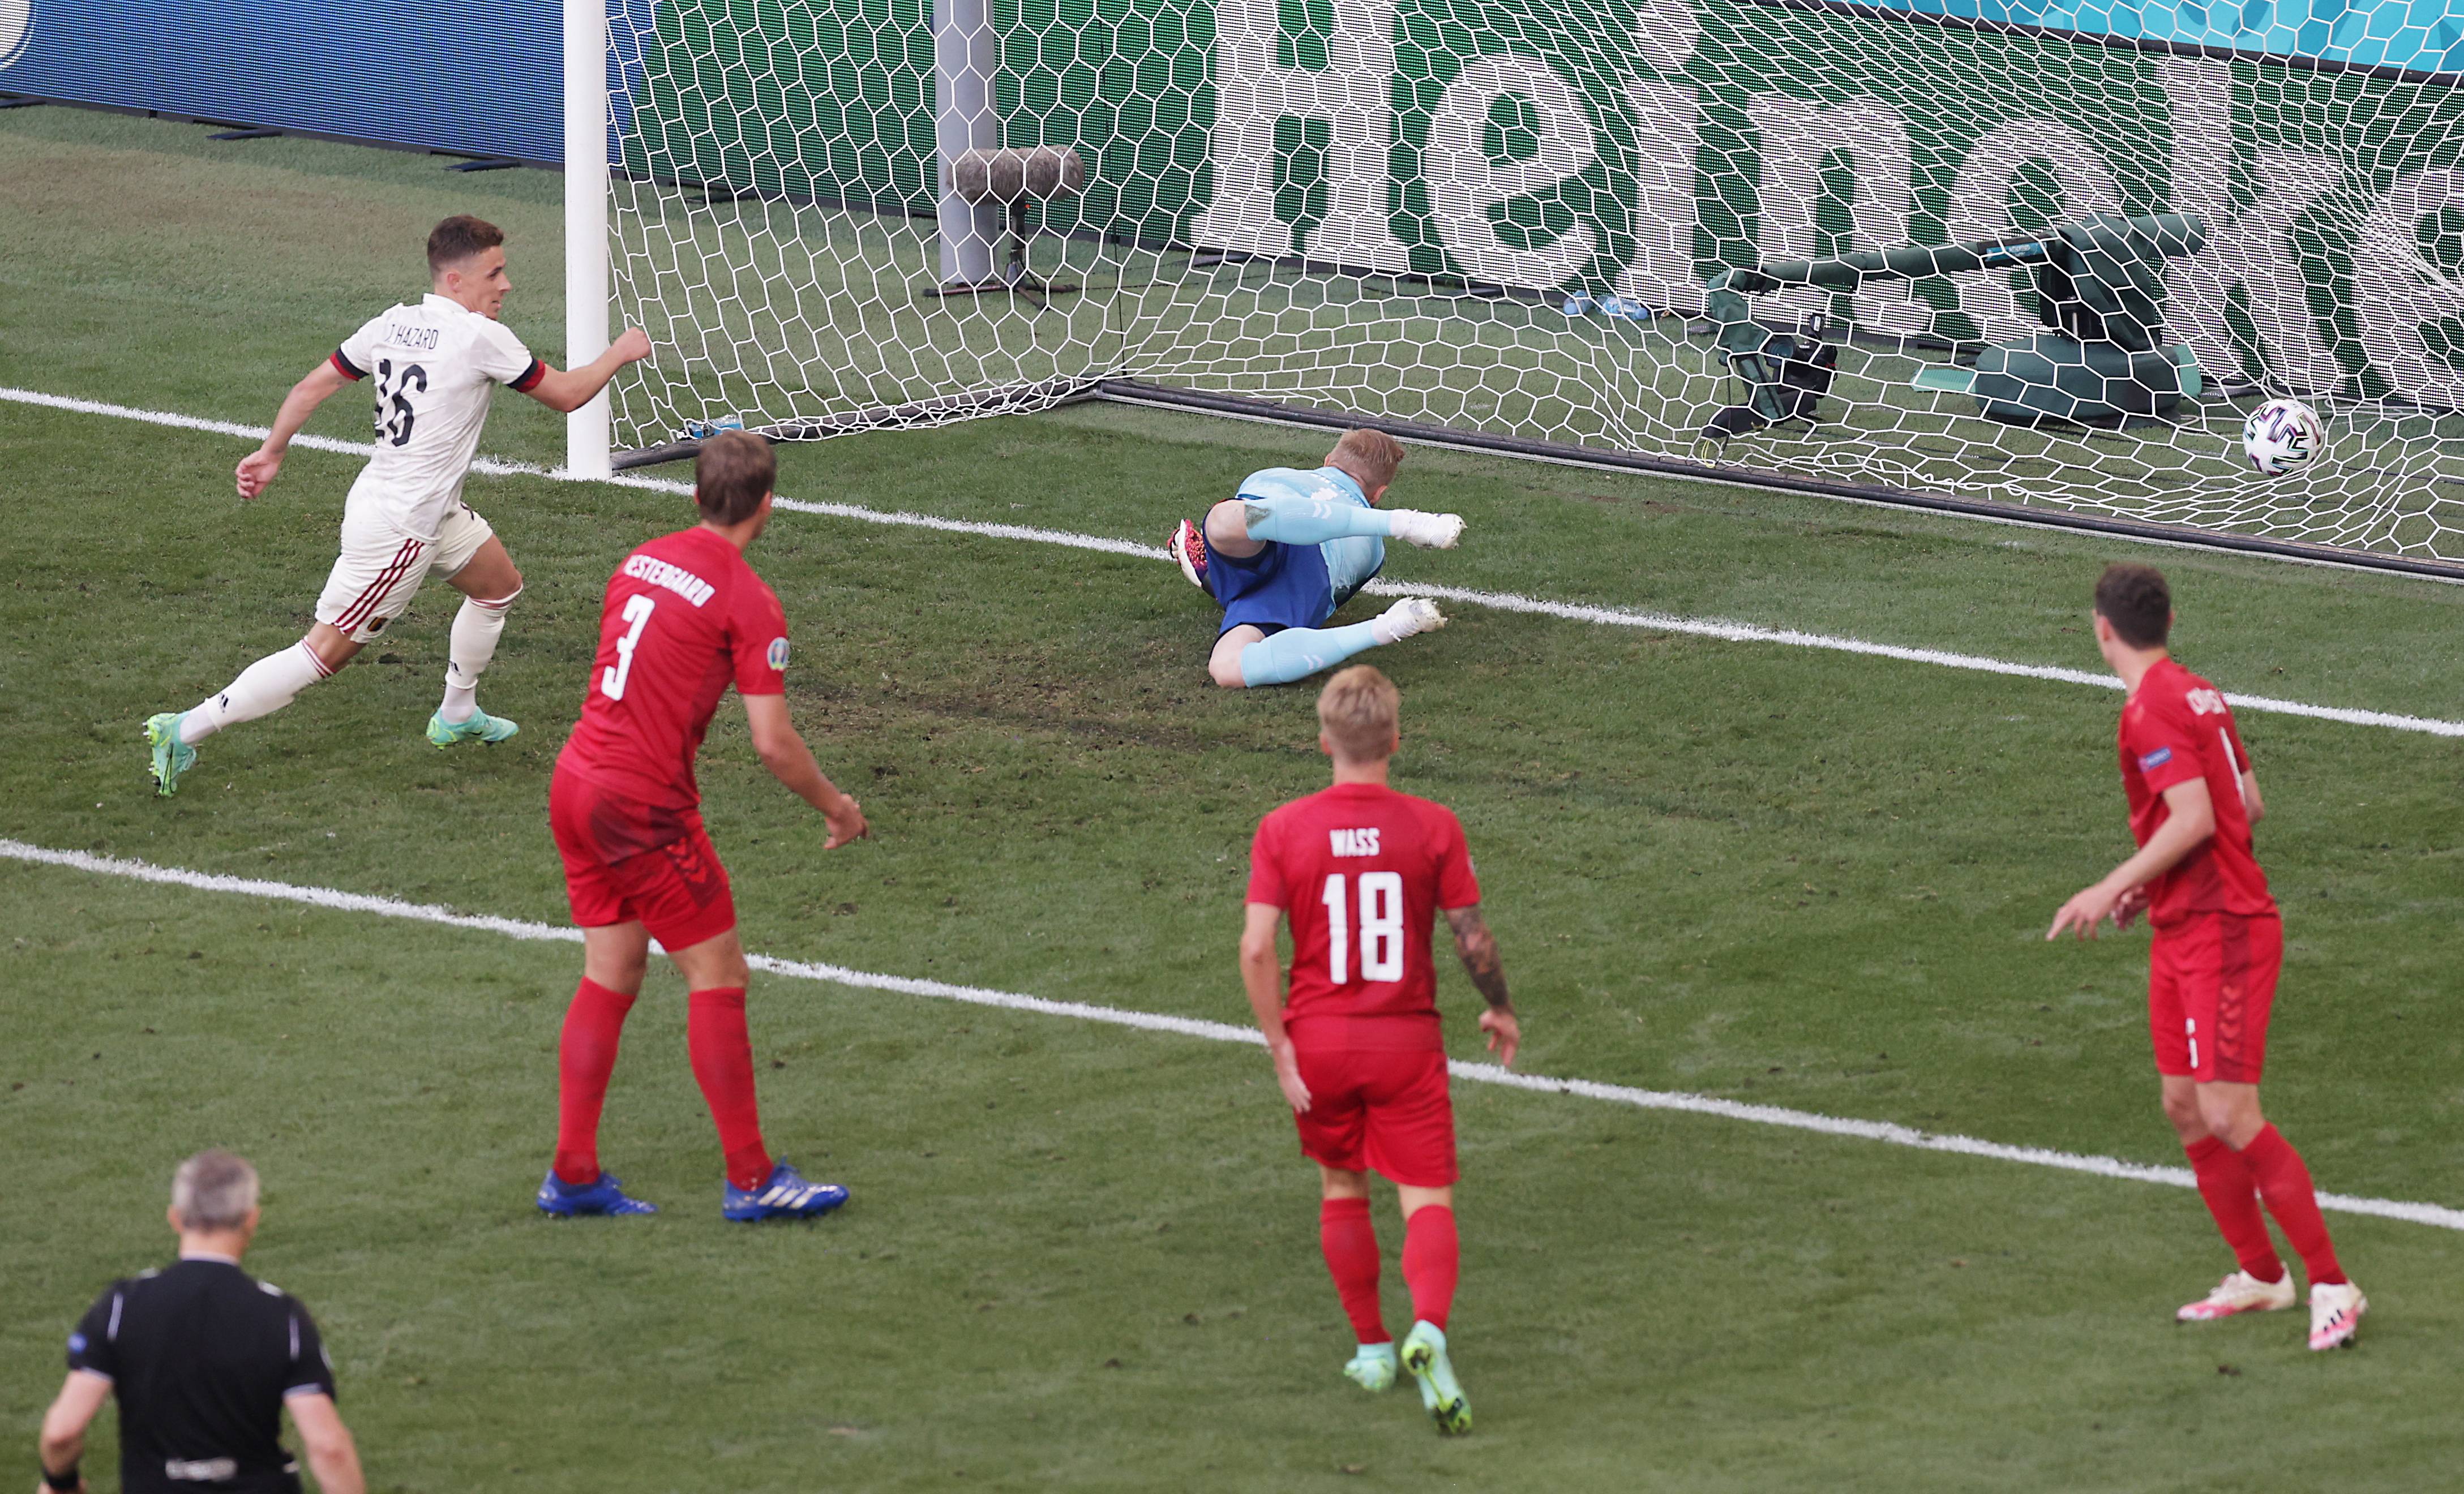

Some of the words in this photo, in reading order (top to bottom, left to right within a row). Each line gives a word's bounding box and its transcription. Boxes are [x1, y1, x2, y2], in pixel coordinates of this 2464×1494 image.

[393, 325, 439, 350] HAZARD
[374, 358, 427, 447] 16
[601, 594, 655, 701] 3
[1329, 827, 1380, 857] WASS
[1322, 872, 1404, 985] 18
